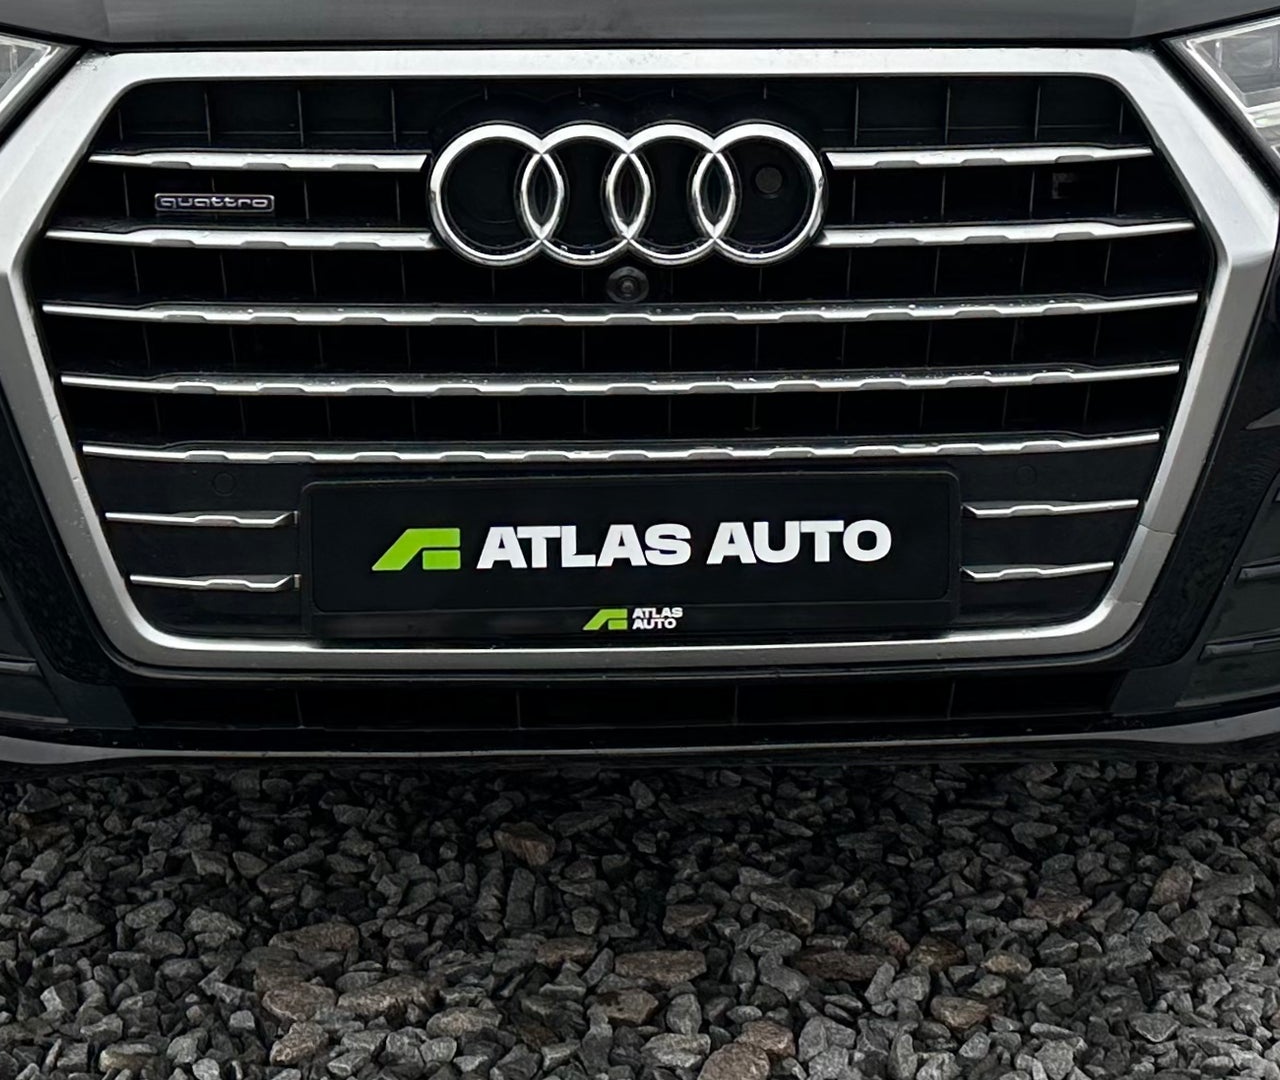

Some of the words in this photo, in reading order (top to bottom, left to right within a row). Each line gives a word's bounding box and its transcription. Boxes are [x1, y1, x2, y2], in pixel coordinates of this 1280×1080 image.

[159, 196, 269, 210] quattro
[476, 523, 692, 570] ATLAS
[706, 519, 893, 565] AUTO
[631, 606, 684, 619] ATLAS
[631, 618, 678, 631] AUTO
